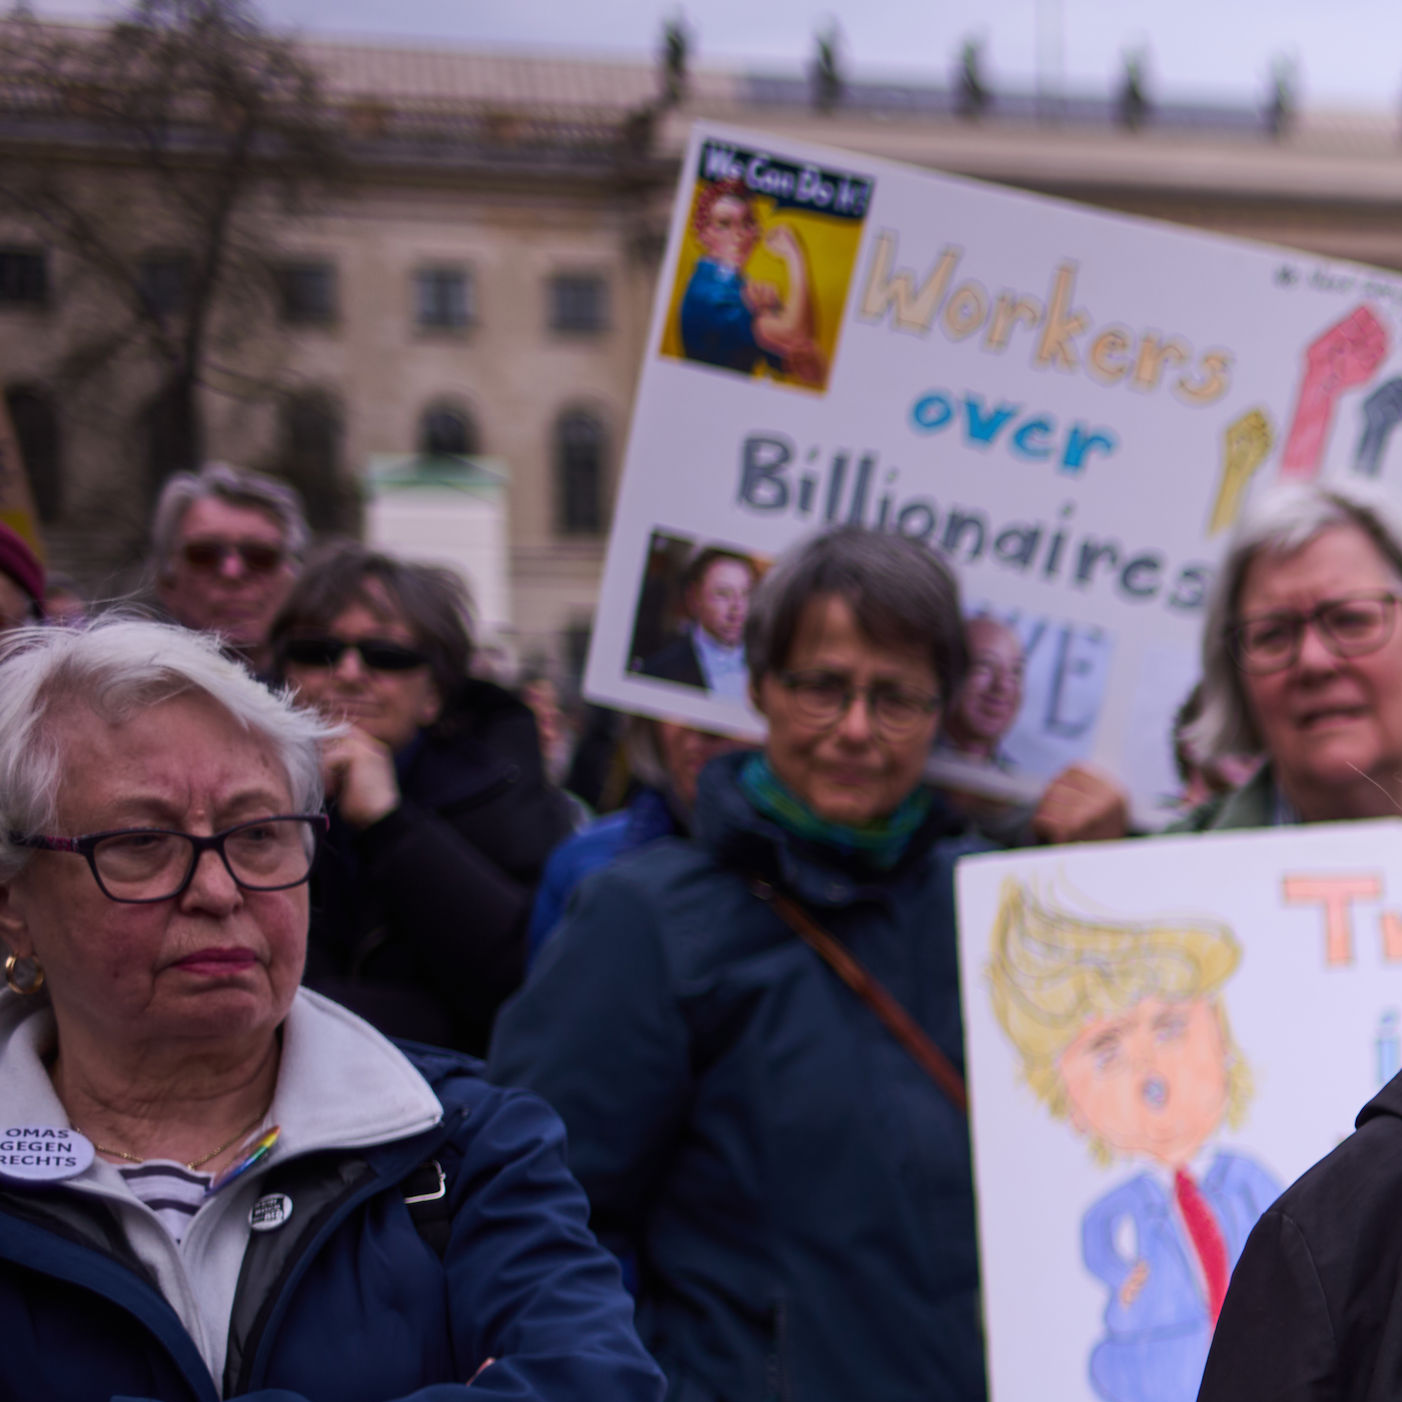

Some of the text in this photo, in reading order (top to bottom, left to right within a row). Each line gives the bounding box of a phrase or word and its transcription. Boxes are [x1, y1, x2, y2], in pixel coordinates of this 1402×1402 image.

[706, 144, 868, 215] We Can Do It!
[859, 232, 1231, 403] Workers
[910, 392, 1117, 474] over
[737, 434, 1212, 612] Billionaires
[0, 1141, 72, 1152] GEGEN
[5, 1128, 69, 1138] OMAS
